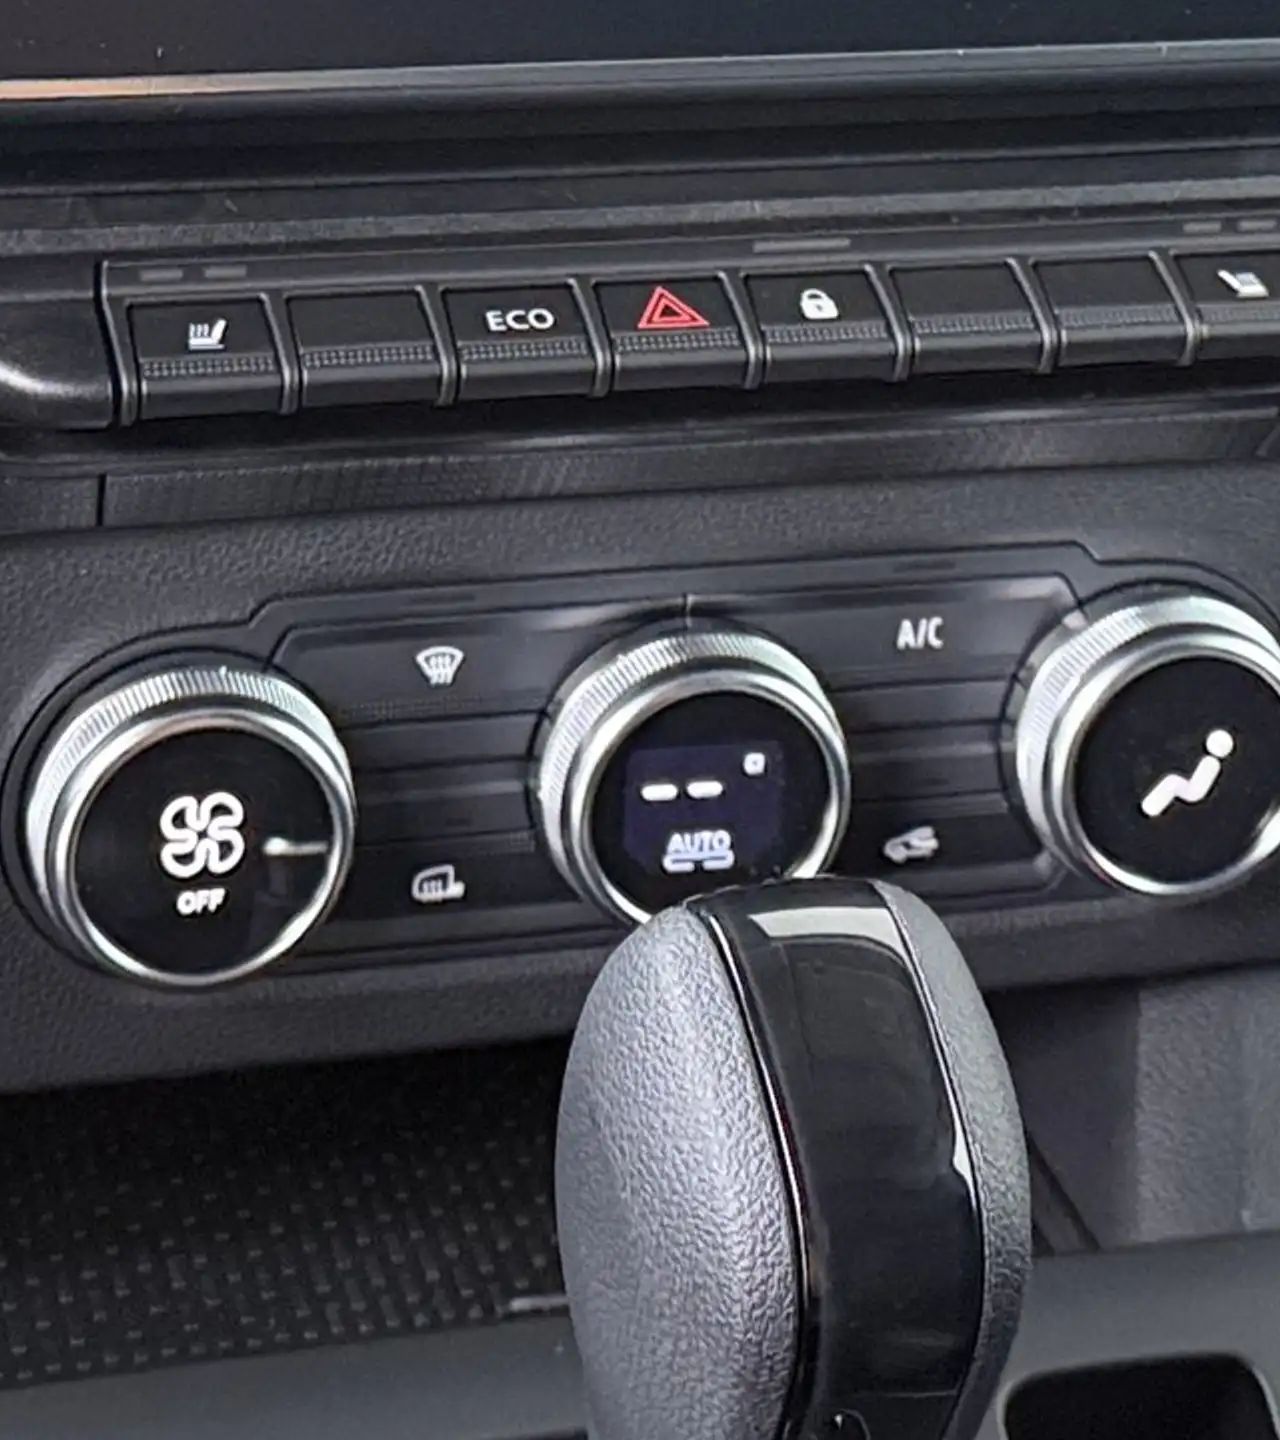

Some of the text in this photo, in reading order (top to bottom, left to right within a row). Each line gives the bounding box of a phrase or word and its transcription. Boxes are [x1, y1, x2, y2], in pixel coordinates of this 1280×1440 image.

[485, 309, 555, 332] ECO
[897, 616, 944, 650] A/C
[666, 829, 732, 852] AUTO
[176, 888, 225, 915] OFF
